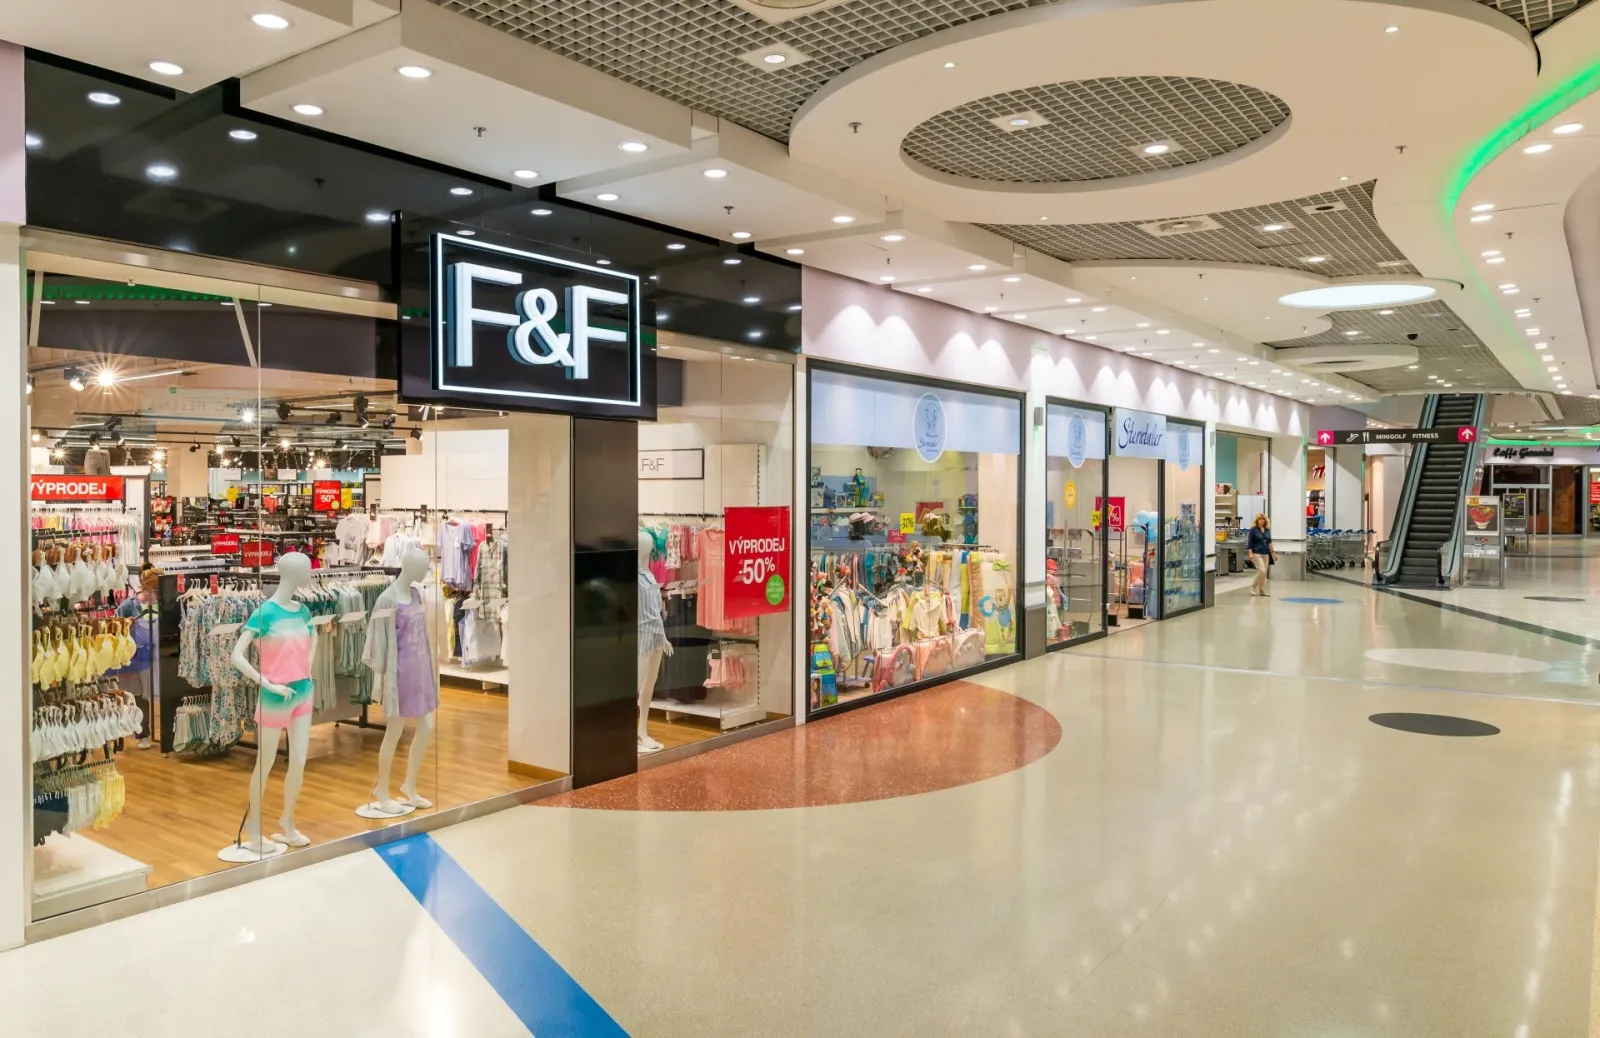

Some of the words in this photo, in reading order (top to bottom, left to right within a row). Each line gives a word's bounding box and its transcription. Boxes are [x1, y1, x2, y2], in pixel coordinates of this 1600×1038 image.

[448, 262, 628, 379] F&F
[641, 457, 665, 472] F&F
[243, 550, 272, 558] VÝPRDEJ
[728, 536, 785, 555] VÝPRODEJ
[738, 556, 776, 585] -50%
